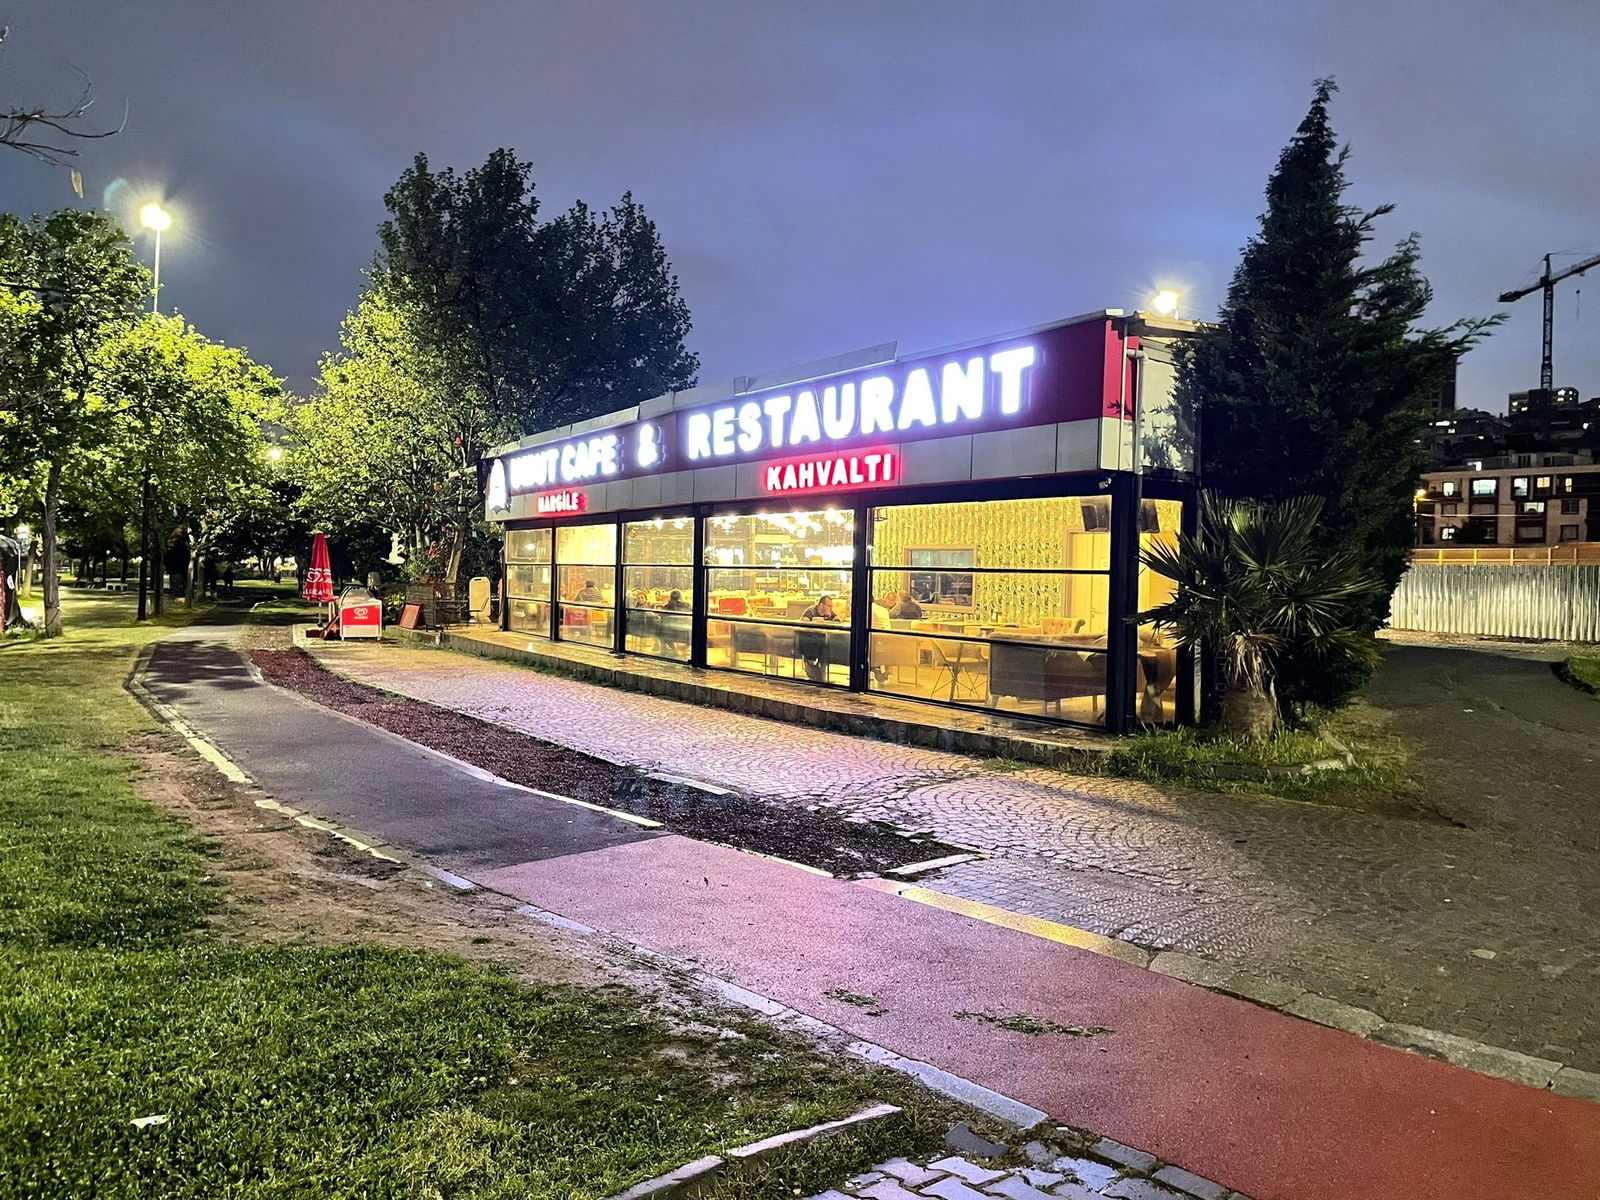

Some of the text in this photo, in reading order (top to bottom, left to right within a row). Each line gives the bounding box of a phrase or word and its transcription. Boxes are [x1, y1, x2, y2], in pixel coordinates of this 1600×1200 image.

[561, 435, 618, 481] CAFE
[637, 424, 659, 467] &
[686, 346, 1036, 459] RESTAURANT
[766, 453, 894, 491] KAHVALTI
